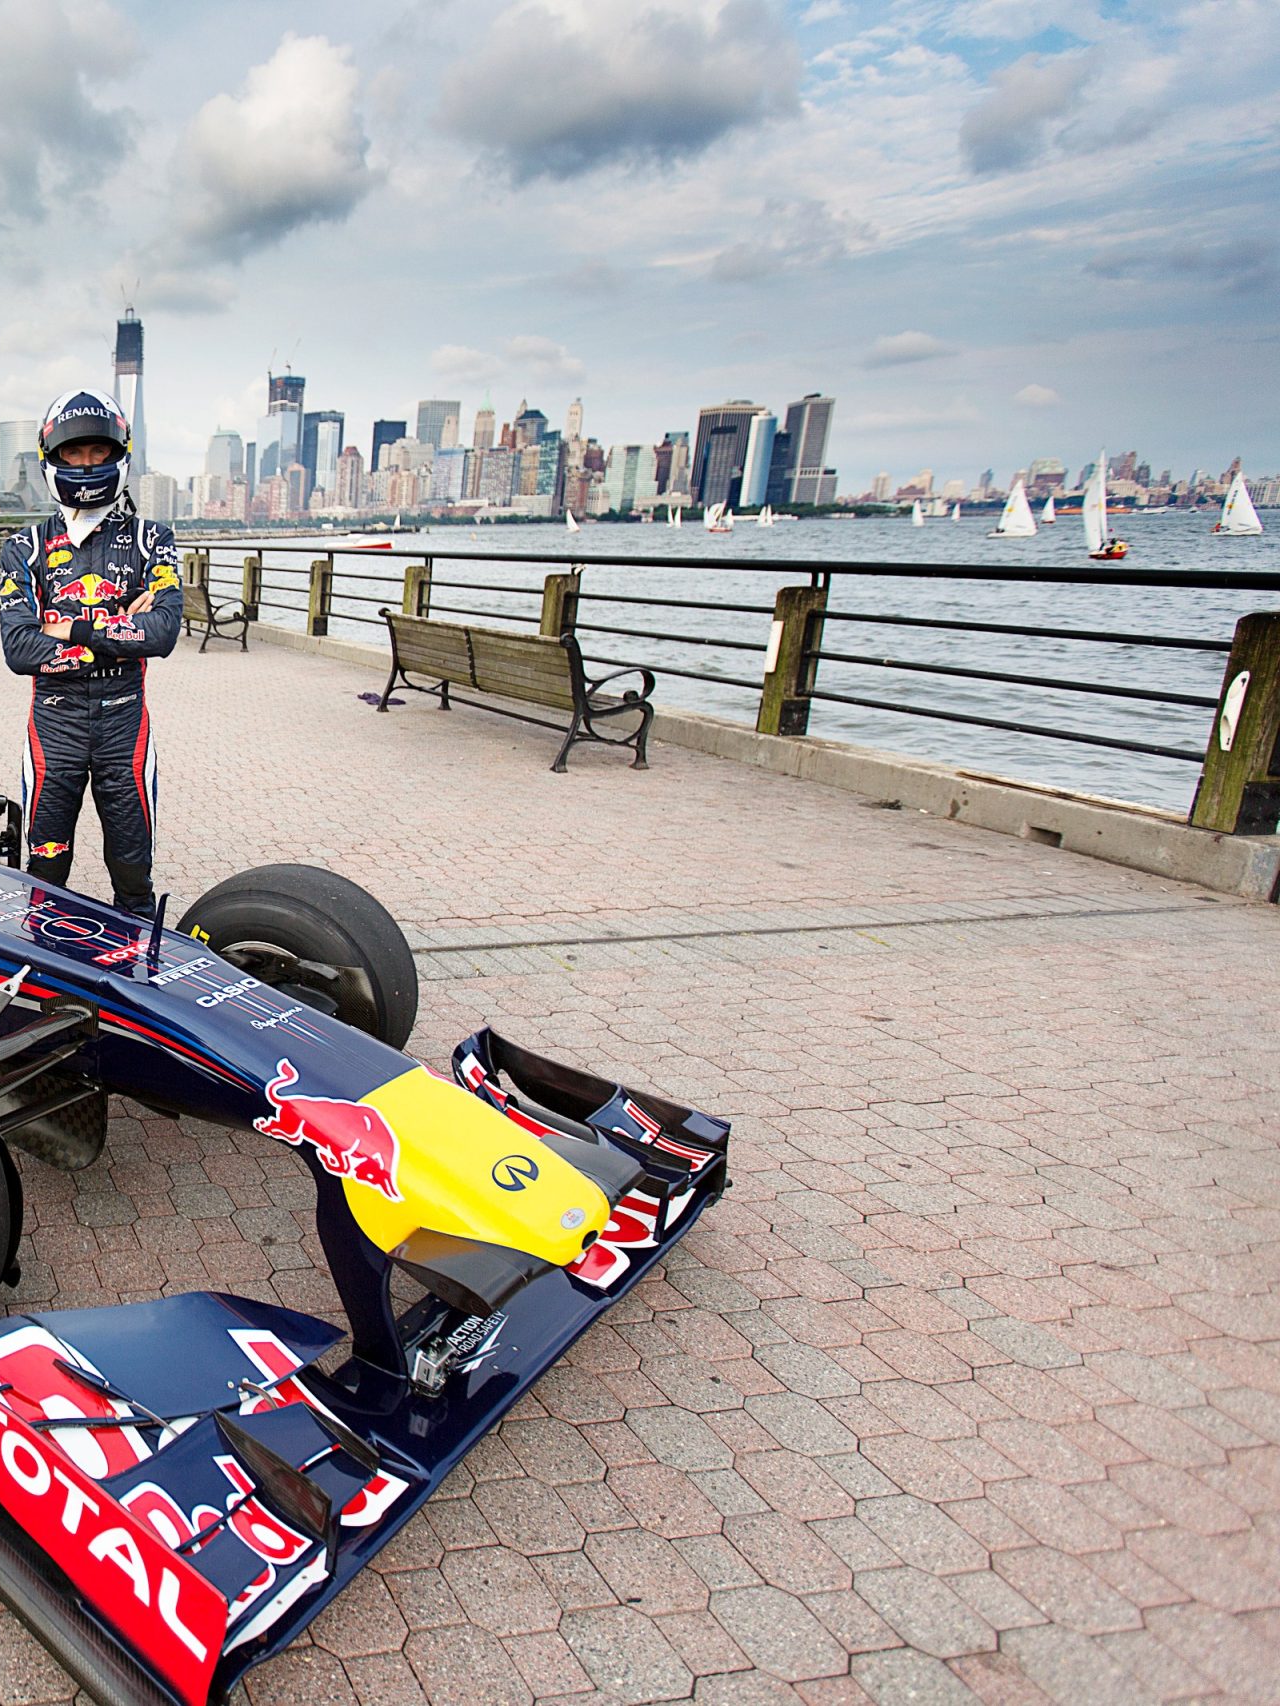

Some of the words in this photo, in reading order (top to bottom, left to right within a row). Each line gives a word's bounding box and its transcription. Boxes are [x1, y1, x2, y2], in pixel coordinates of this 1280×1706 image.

[57, 406, 112, 424] RENAULT
[46, 535, 72, 551] OTAL
[46, 567, 74, 581] GOX
[106, 628, 124, 640] Red
[125, 628, 146, 641] Bull
[51, 920, 93, 936] 1
[148, 956, 217, 986] PIRELLI
[195, 977, 263, 1008] CASIO
[447, 1314, 485, 1346] ACTION
[458, 1331, 483, 1353] ROAD
[475, 1309, 506, 1336] SAFETY
